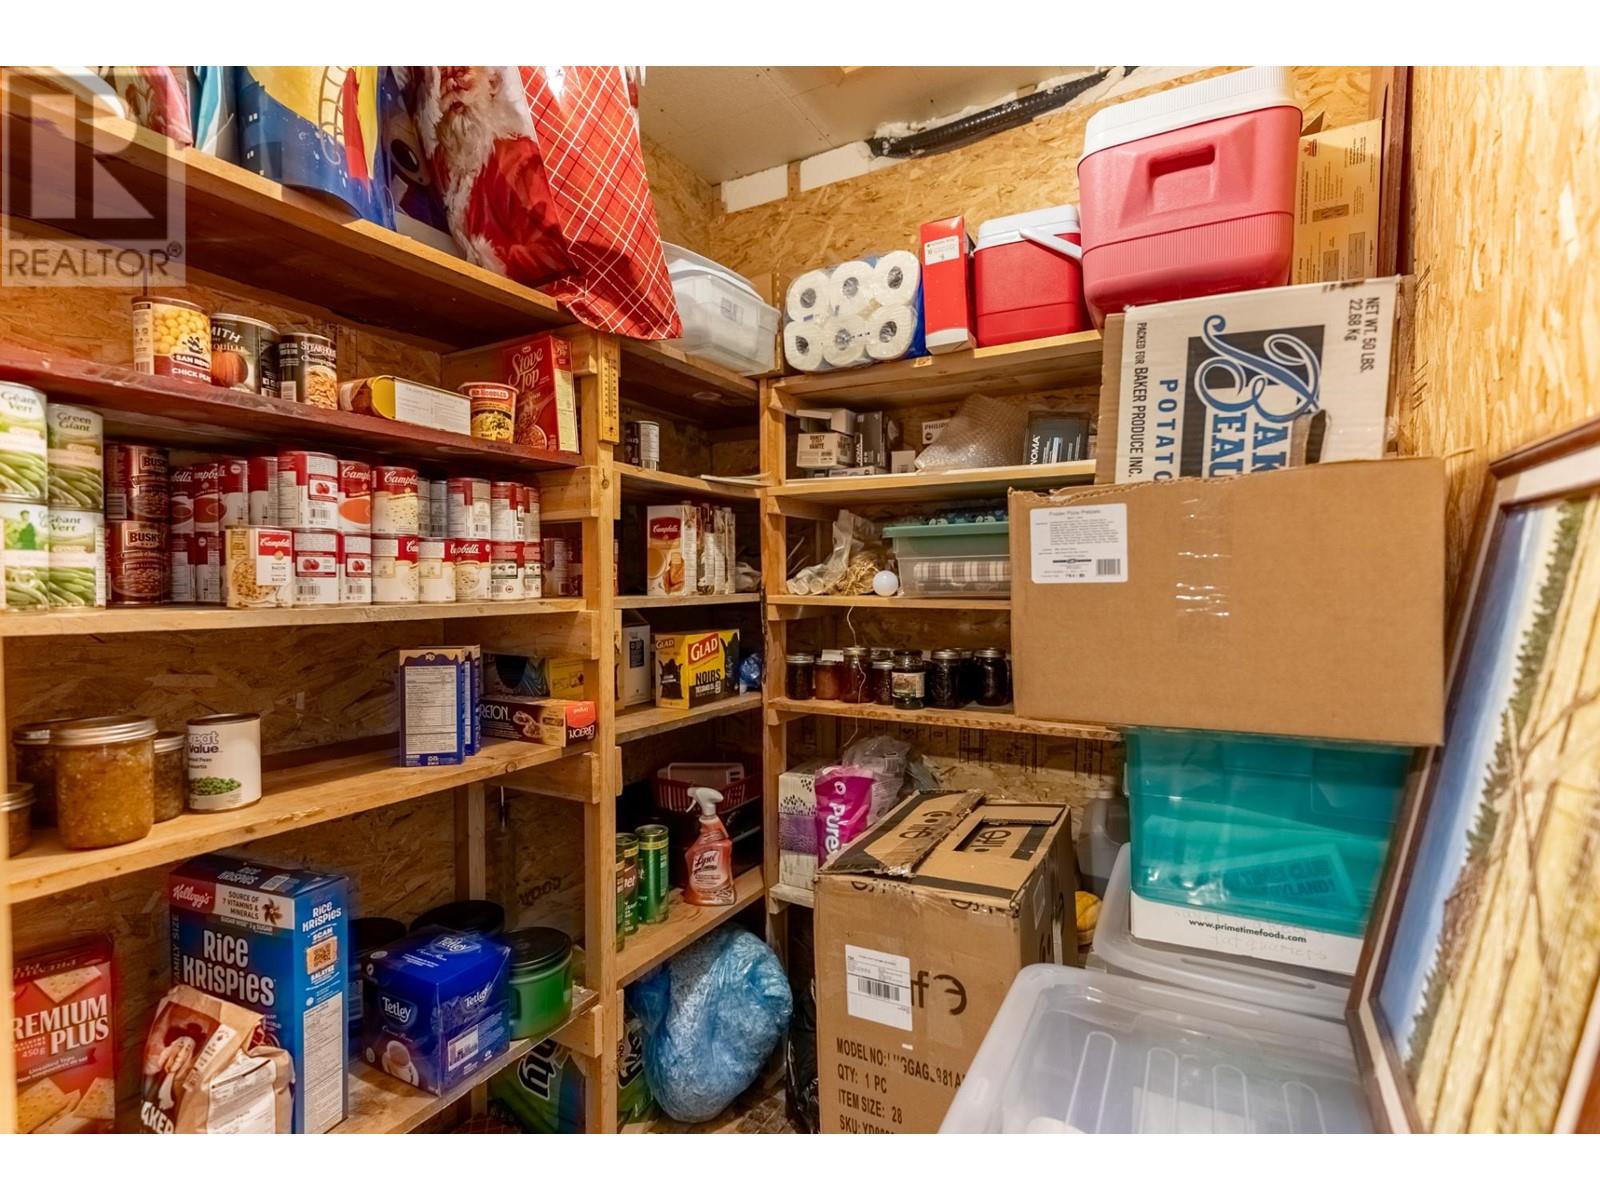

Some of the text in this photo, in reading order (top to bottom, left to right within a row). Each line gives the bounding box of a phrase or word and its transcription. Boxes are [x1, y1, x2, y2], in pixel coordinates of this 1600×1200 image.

[1349, 298, 1363, 327] 22.68
[1365, 297, 1380, 317] NET
[1362, 337, 1377, 352] 50
[171, 368, 197, 379] CHICK
[1131, 366, 1149, 403] BAKER
[57, 411, 92, 425] Green
[58, 419, 91, 432] Giant
[1128, 404, 1147, 456] PRODUCE
[1127, 456, 1144, 478] INC.
[655, 639, 674, 650] GLAD
[690, 637, 719, 662] GLAD
[695, 668, 721, 687] NOIRS
[172, 882, 213, 909] Kellogg's
[227, 899, 253, 911] VITAMINS
[228, 890, 250, 903] SOURCE
[230, 907, 259, 920] MINERALS
[1188, 919, 1308, 945] www.primetimefoods.com
[381, 995, 412, 1024] Tetley
[49, 1016, 110, 1056] PLUS
[836, 1037, 869, 1062] MODEL
[837, 1063, 887, 1094] QTY: 1 PC
[838, 1087, 903, 1125] ITEM SIZE: 28
